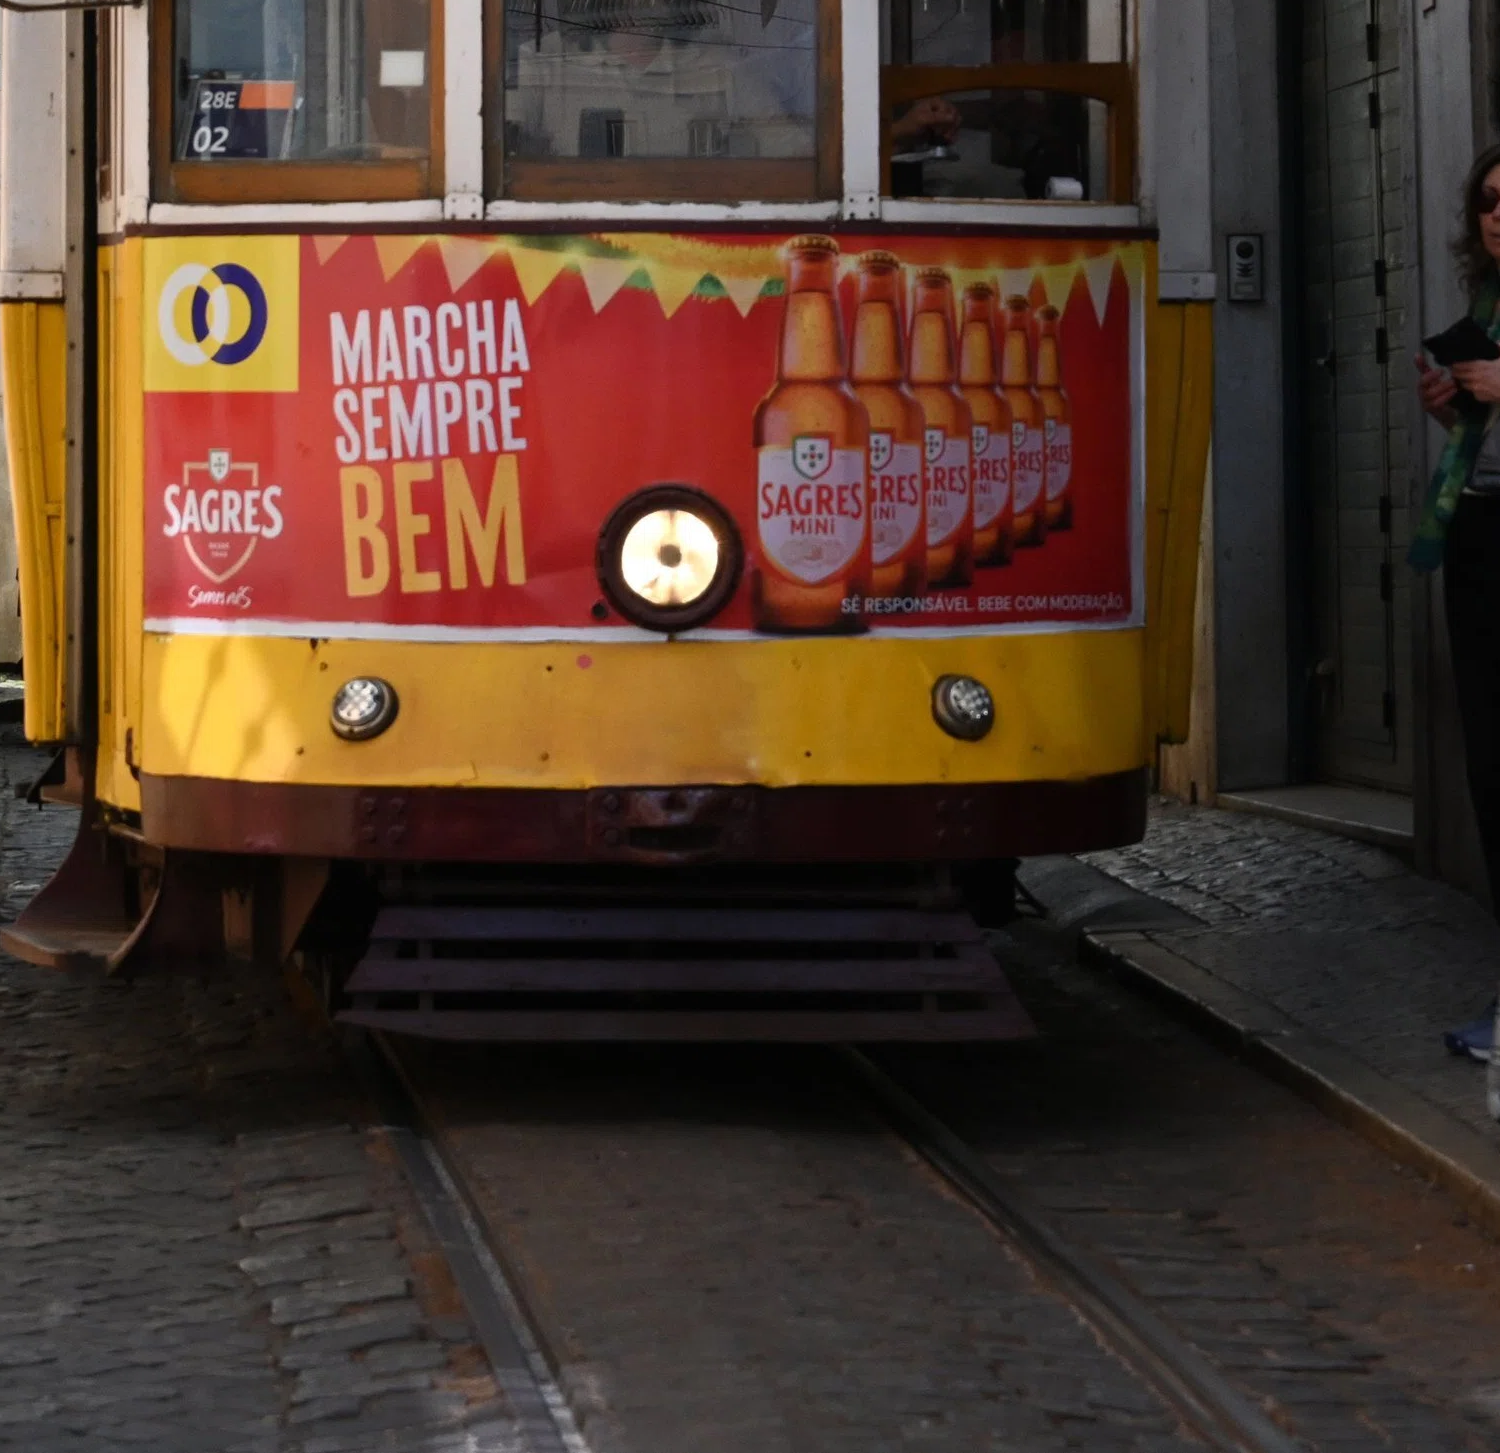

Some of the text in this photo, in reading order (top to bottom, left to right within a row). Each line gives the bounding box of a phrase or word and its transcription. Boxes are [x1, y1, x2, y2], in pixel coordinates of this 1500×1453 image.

[201, 91, 237, 109] 28E
[193, 126, 229, 153] 02
[330, 298, 530, 385] MARCHA
[333, 376, 527, 463] SEMPRE
[163, 484, 283, 539] SAGRES
[761, 482, 863, 520] SAGRES
[339, 453, 526, 597] BEM
[978, 595, 1012, 611] BEBE
[1015, 595, 1048, 611] COM
